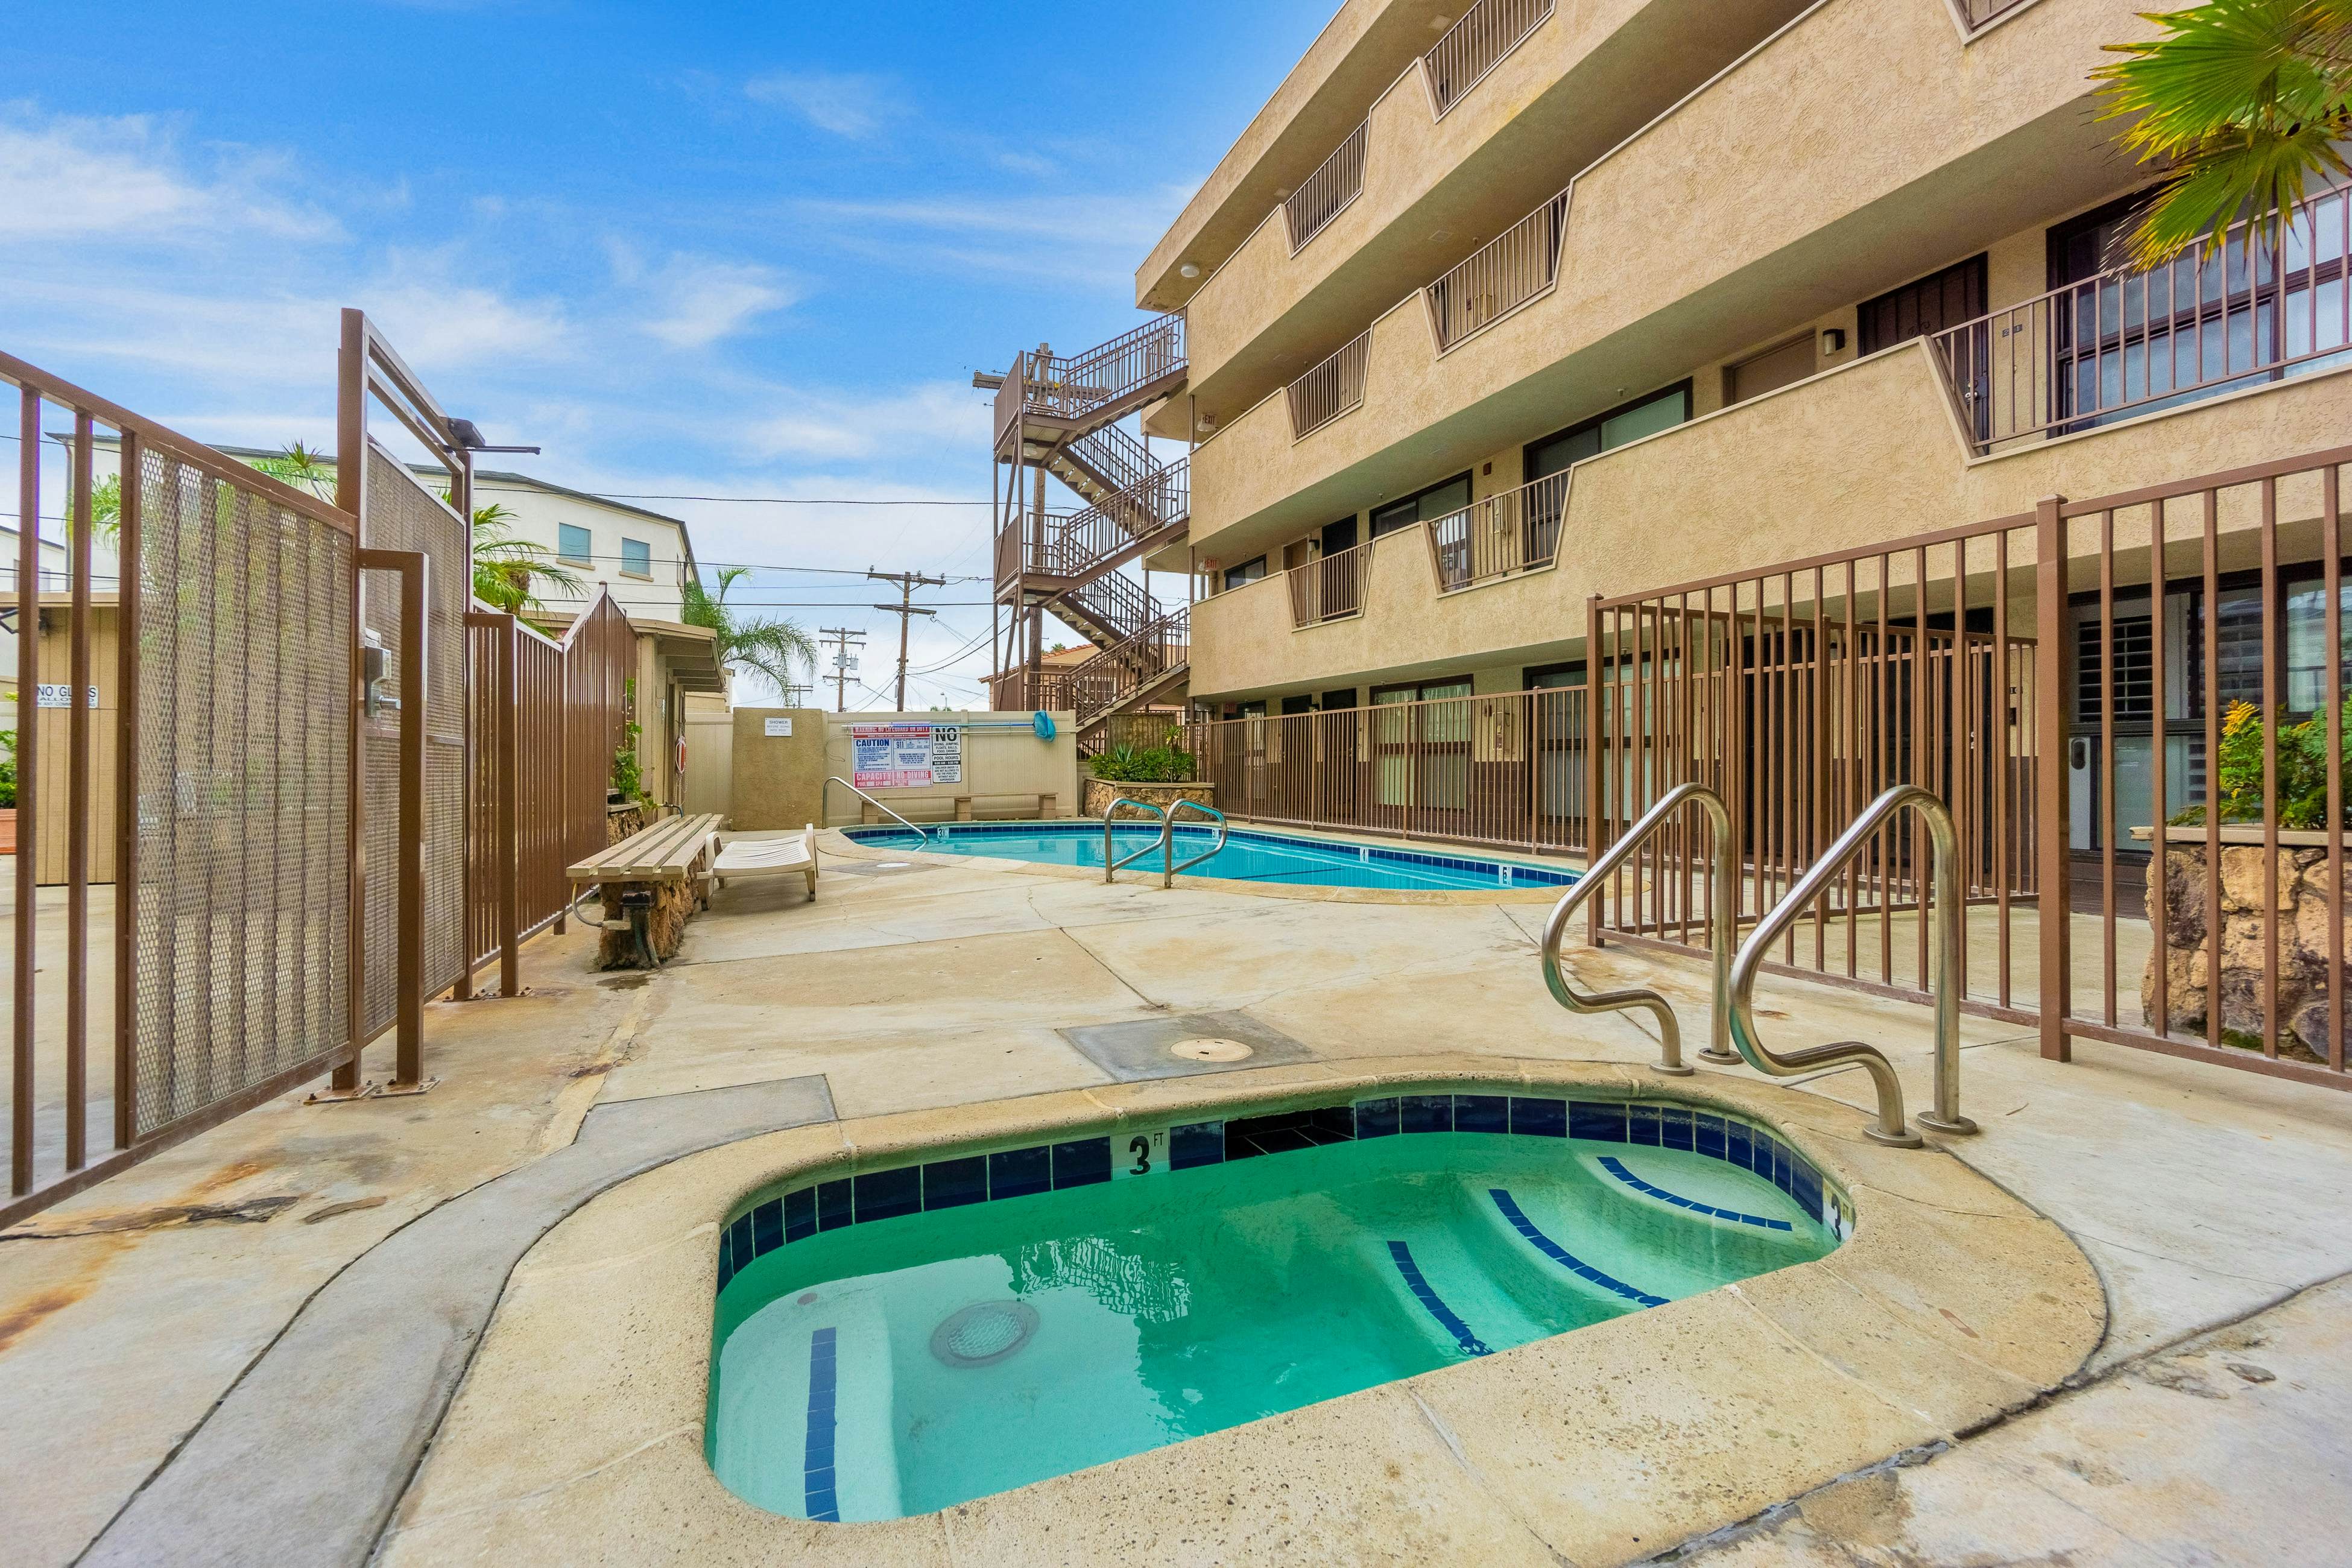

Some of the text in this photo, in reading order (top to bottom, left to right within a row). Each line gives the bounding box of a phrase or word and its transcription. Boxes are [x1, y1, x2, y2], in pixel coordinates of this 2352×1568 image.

[1205, 414, 1216, 425] EXIT
[1207, 558, 1217, 568] EXIT
[38, 686, 96, 697] NO GLS
[935, 727, 957, 742] NO
[856, 739, 890, 747] CAUTION
[856, 772, 891, 780] CAPACITY
[1130, 1133, 1164, 1175] 3 FT
[1830, 1193, 1842, 1242] 3
